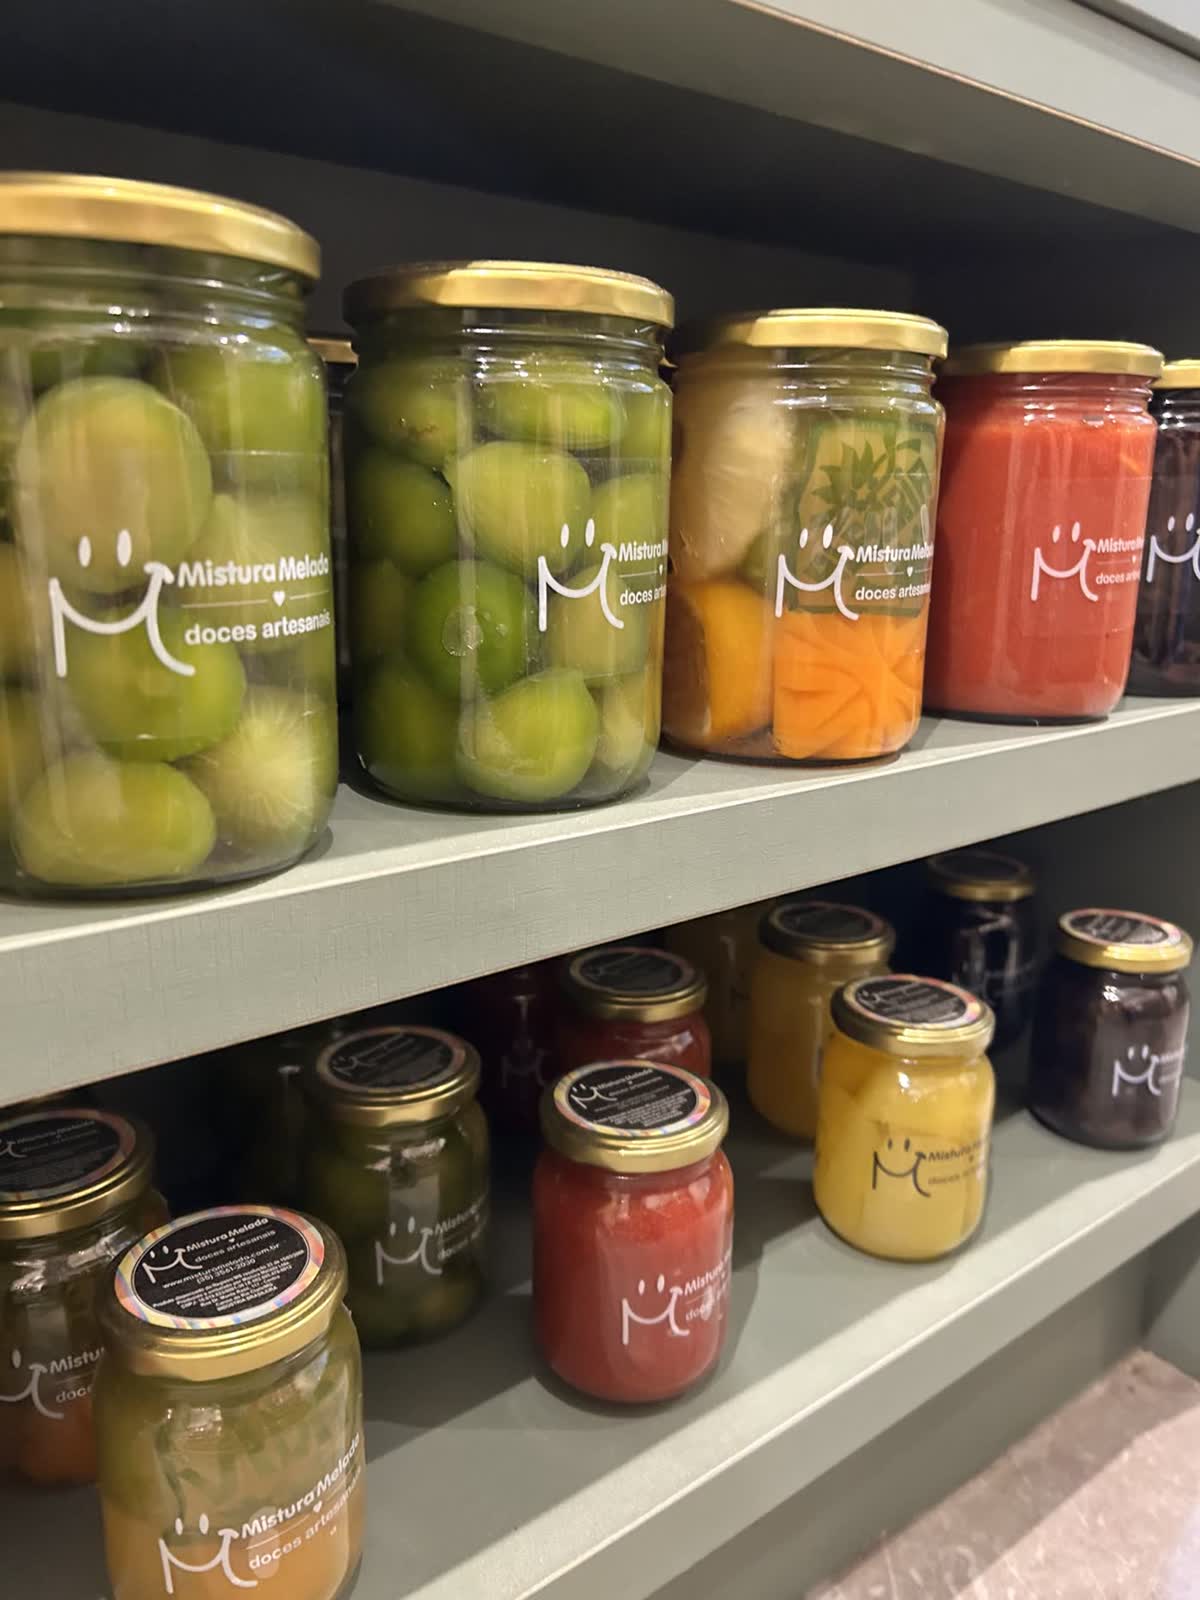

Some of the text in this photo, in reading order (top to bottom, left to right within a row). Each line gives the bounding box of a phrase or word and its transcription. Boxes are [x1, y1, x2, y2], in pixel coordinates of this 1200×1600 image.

[618, 540, 661, 562] Mistura
[856, 544, 911, 563] Mistura
[177, 561, 277, 588] Mistura
[620, 588, 653, 606] doces
[855, 586, 897, 600] doces
[184, 609, 331, 646] doces artesanais
[186, 1232, 227, 1253] Mistura
[50, 1346, 104, 1375] Mistu
[55, 1385, 92, 1403] doc
[240, 1490, 315, 1540] Mistura
[248, 1537, 303, 1570] doces
